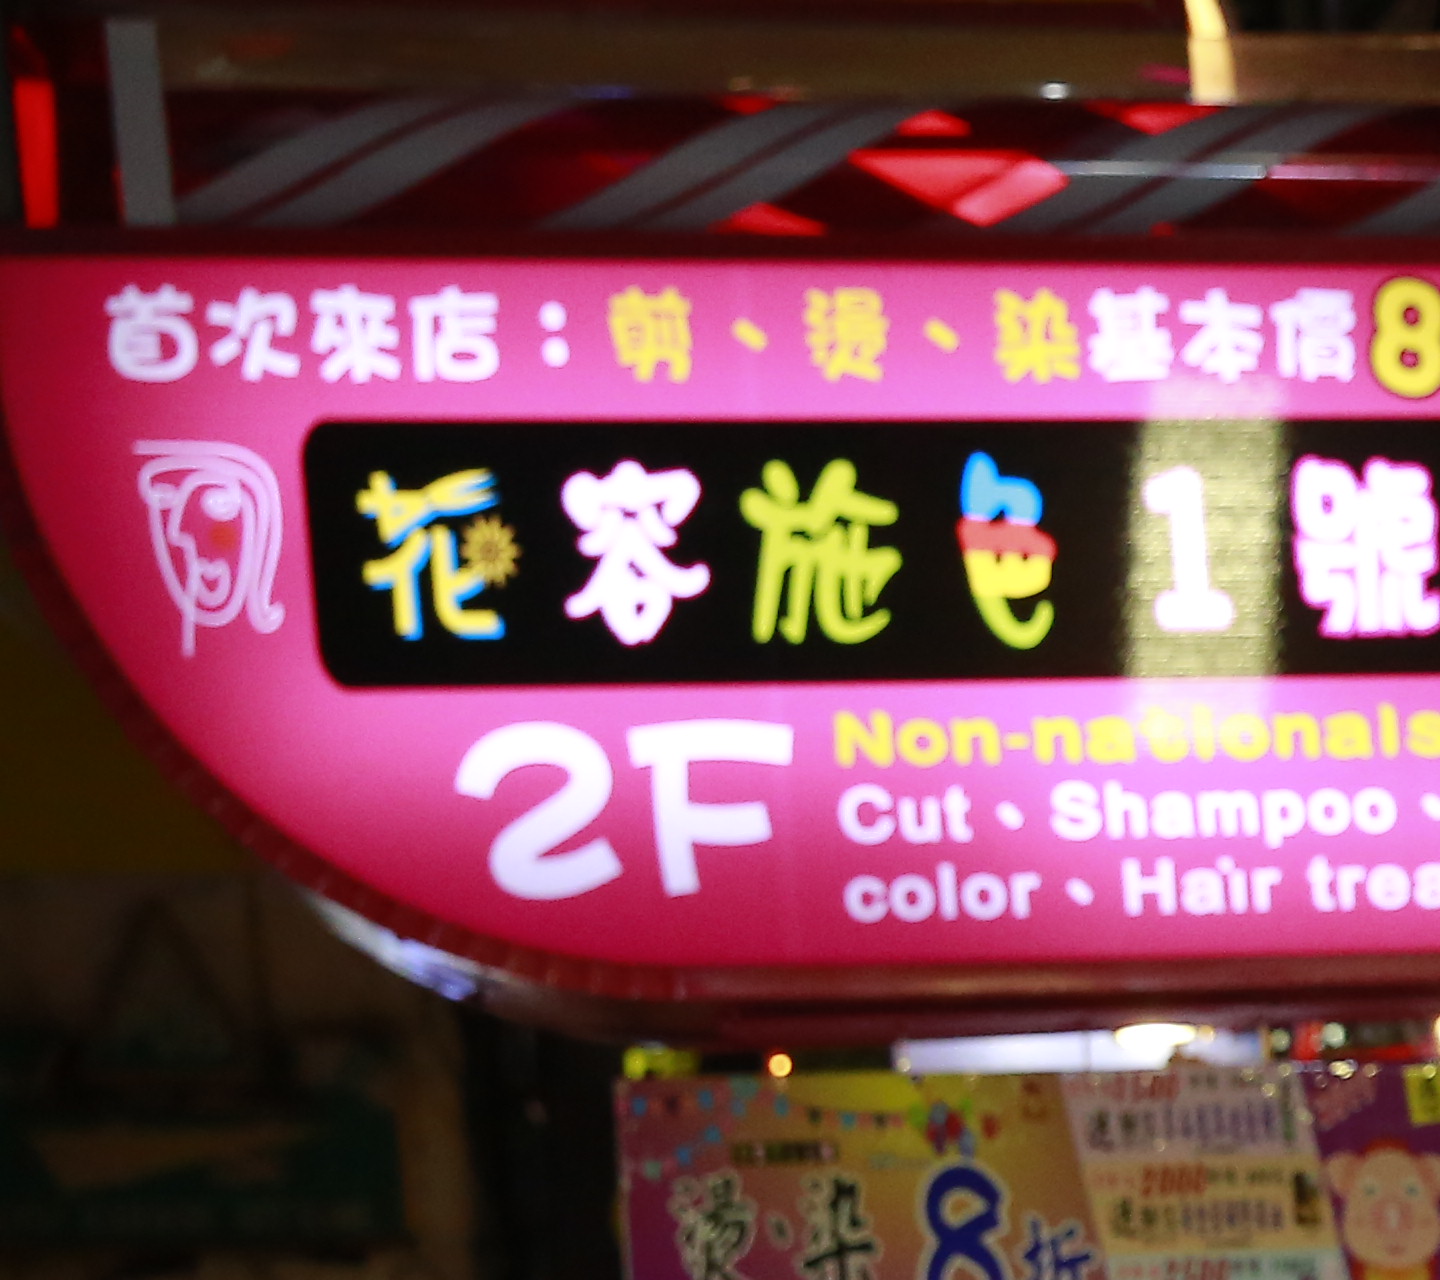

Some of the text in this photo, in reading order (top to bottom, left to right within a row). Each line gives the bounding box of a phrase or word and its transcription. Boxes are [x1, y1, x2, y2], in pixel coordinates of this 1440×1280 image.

[455, 718, 794, 901] 2F
[837, 784, 974, 845] Cut
[1050, 778, 1397, 848] Shampoo
[843, 861, 1043, 924] color
[1122, 855, 1284, 917] Hair
